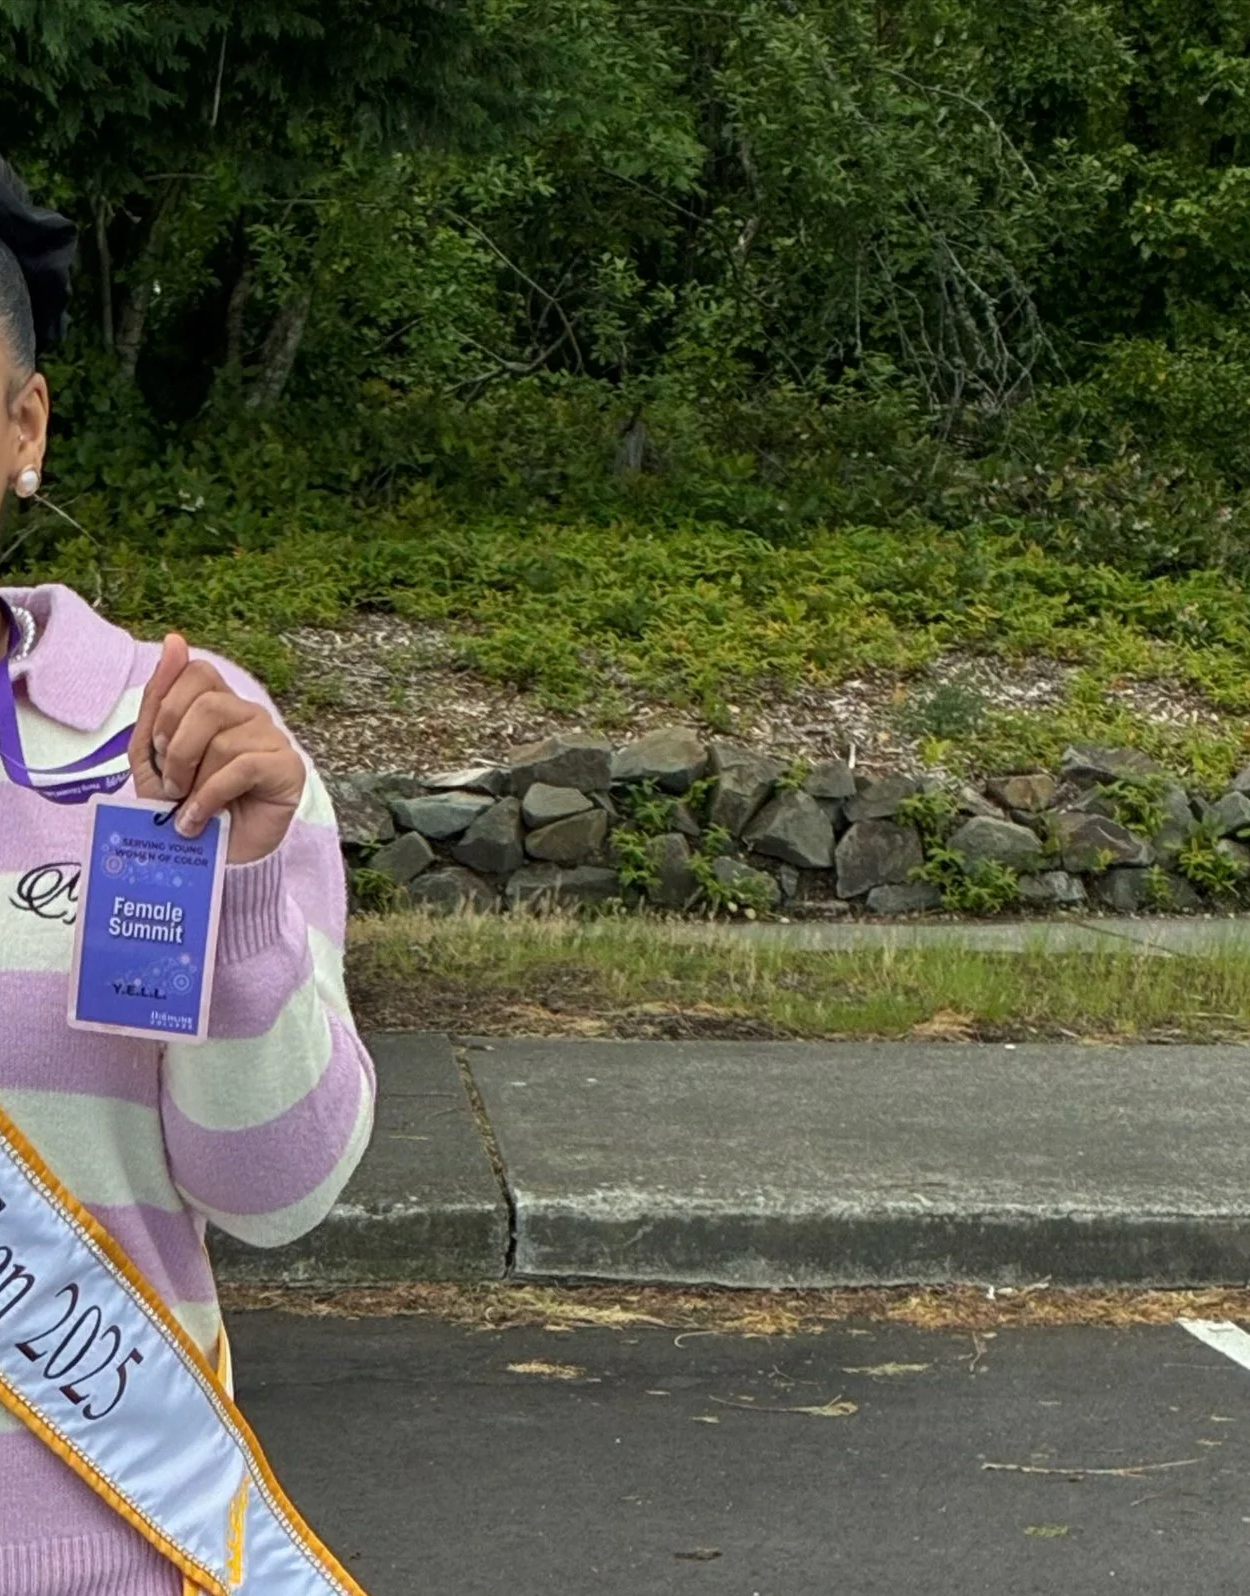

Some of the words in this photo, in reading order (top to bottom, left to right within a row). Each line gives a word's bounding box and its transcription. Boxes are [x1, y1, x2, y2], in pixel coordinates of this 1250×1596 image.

[115, 848, 155, 860] WOMEN
[158, 853, 170, 862] OF
[174, 855, 209, 867] COLOR
[123, 838, 166, 851] SERVING
[169, 843, 204, 855] YOUNG
[112, 896, 183, 923] Female
[108, 917, 184, 944] Summit
[113, 983, 167, 999] Y.E.L.L.
[15, 1283, 144, 1420] 2025
